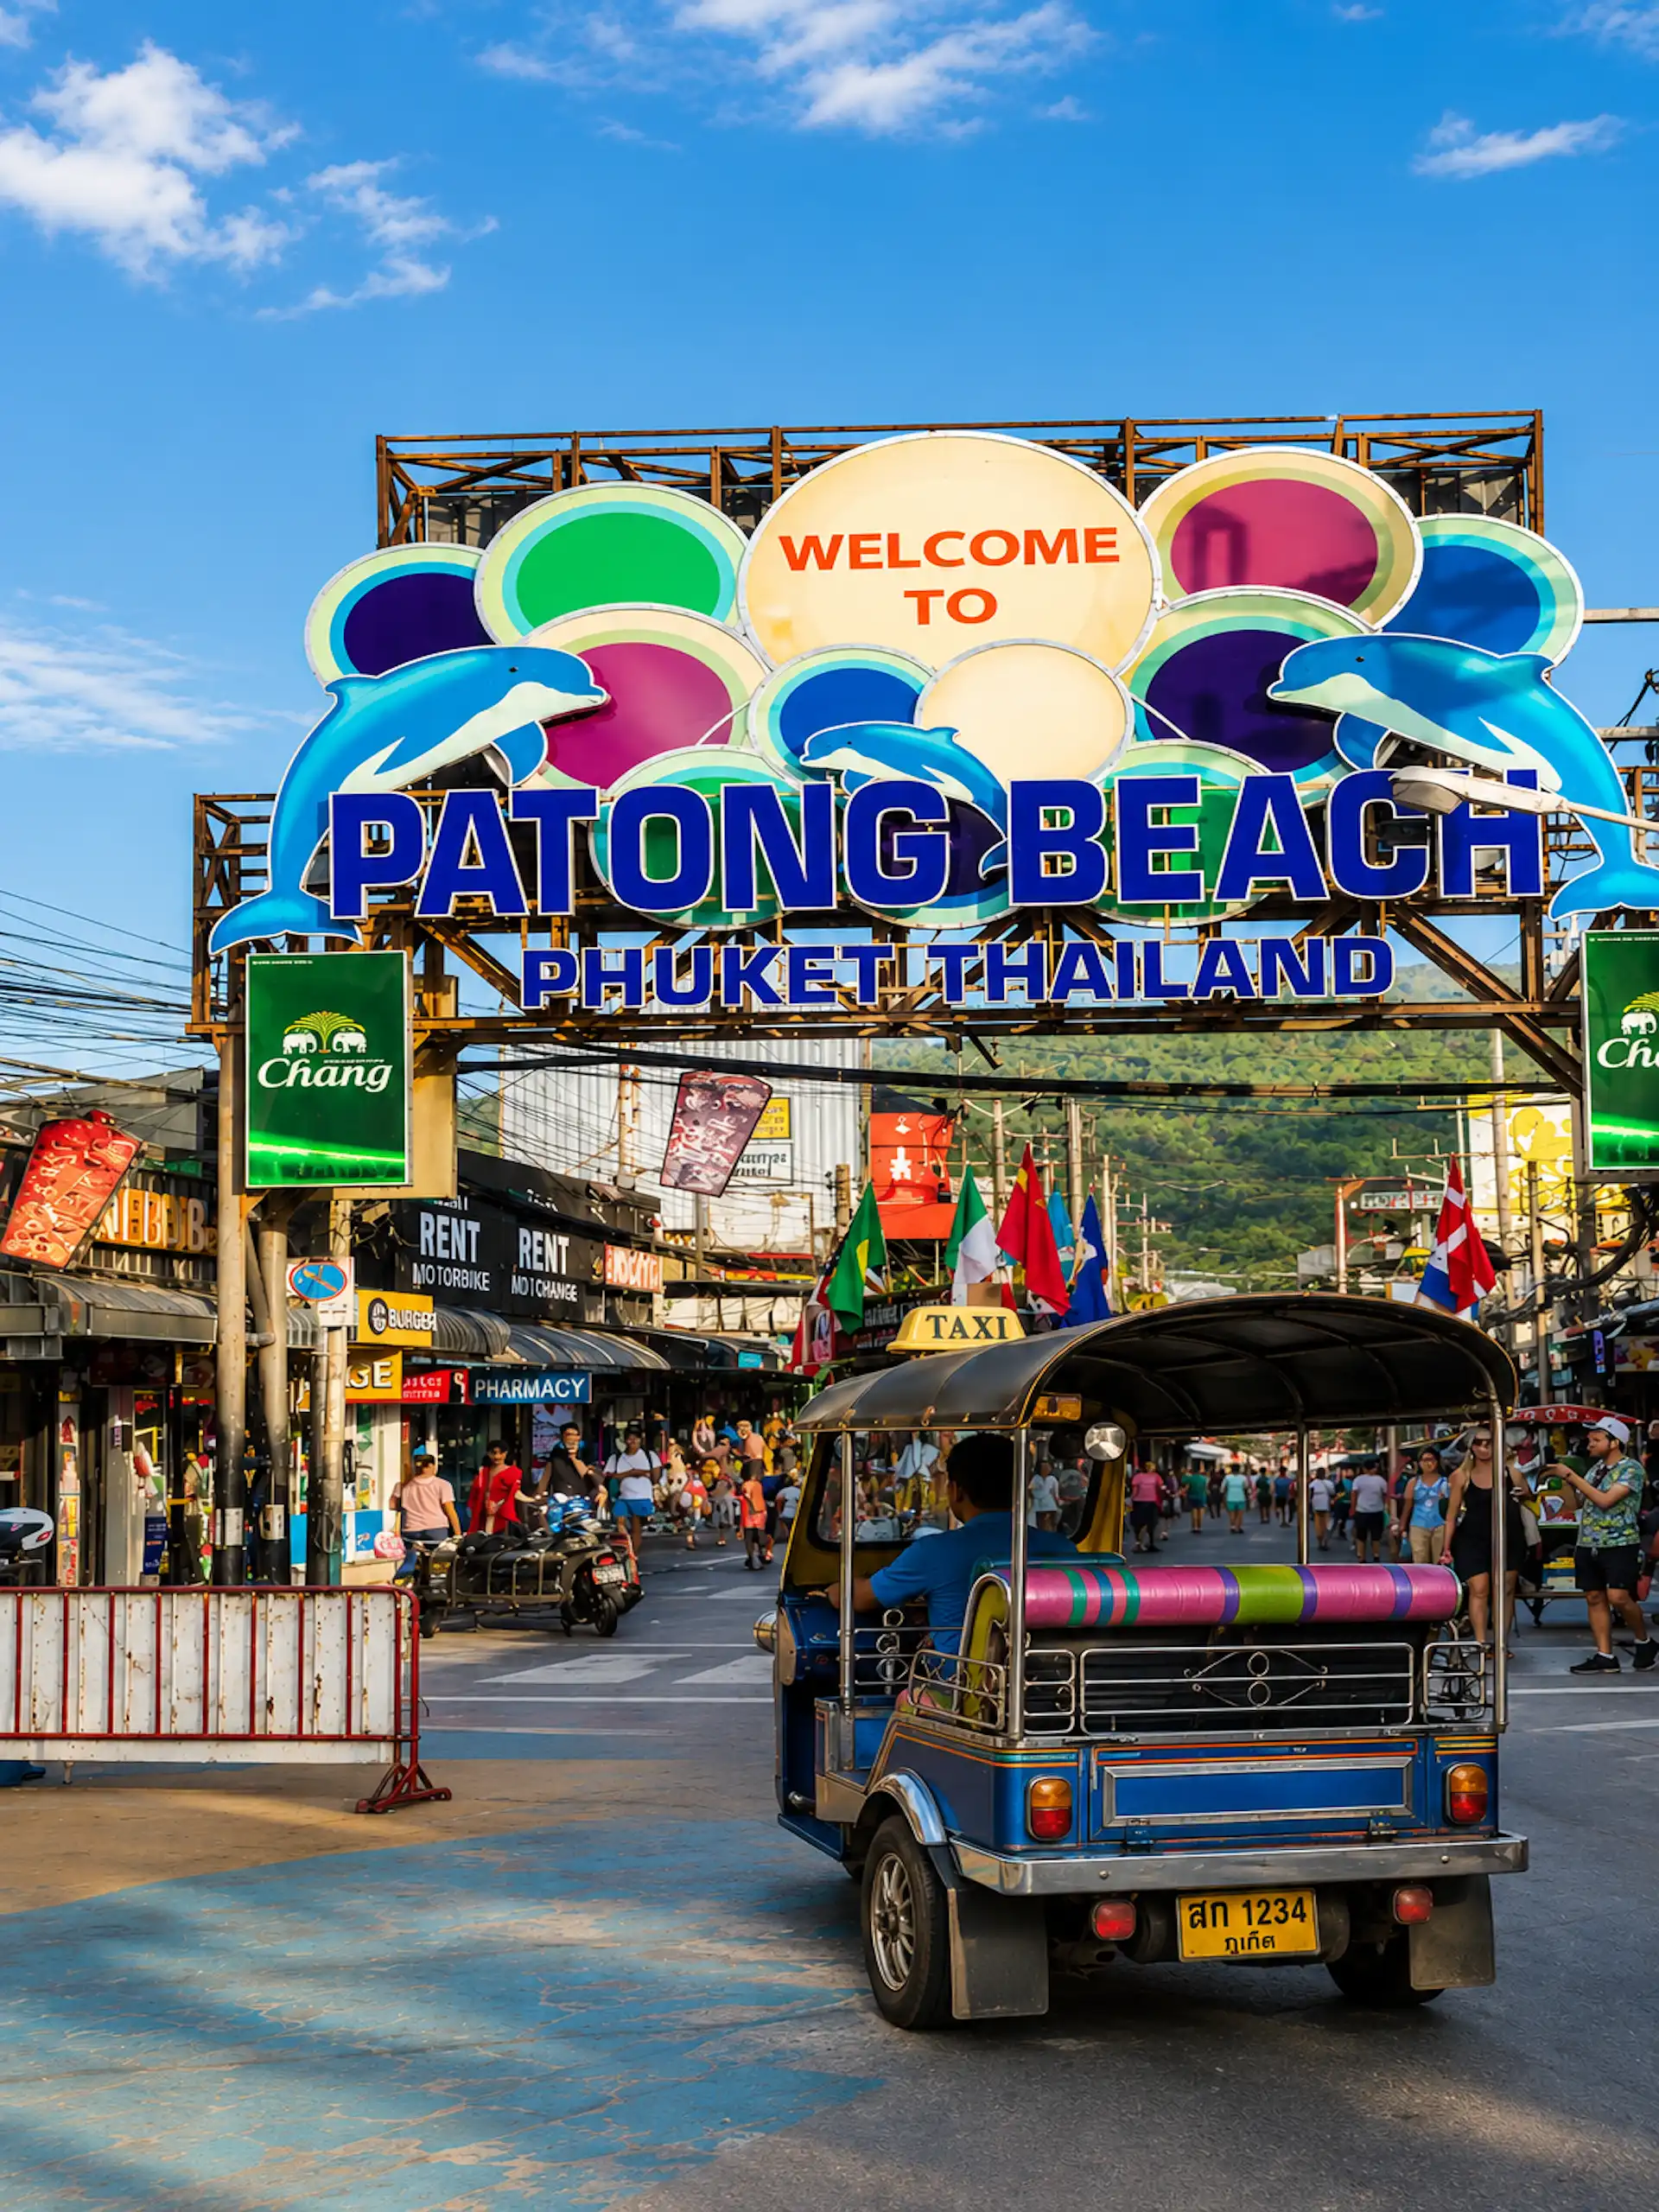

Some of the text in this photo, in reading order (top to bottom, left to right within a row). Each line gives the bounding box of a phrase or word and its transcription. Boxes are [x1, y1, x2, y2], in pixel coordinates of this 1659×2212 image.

[779, 527, 1120, 571] WELCOME
[904, 588, 998, 626] TO
[328, 767, 1545, 920] PATONG BEACH
[520, 935, 1395, 1009] PHUKET THAILAND
[1596, 1038, 1659, 1069] Ch
[257, 1057, 393, 1093] Chang
[420, 1211, 480, 1263] RENT
[518, 1227, 570, 1276] RENT
[925, 1314, 1009, 1339] TAXI
[475, 1377, 586, 1399] PHARMACY
[1242, 1897, 1306, 1926] 1234
